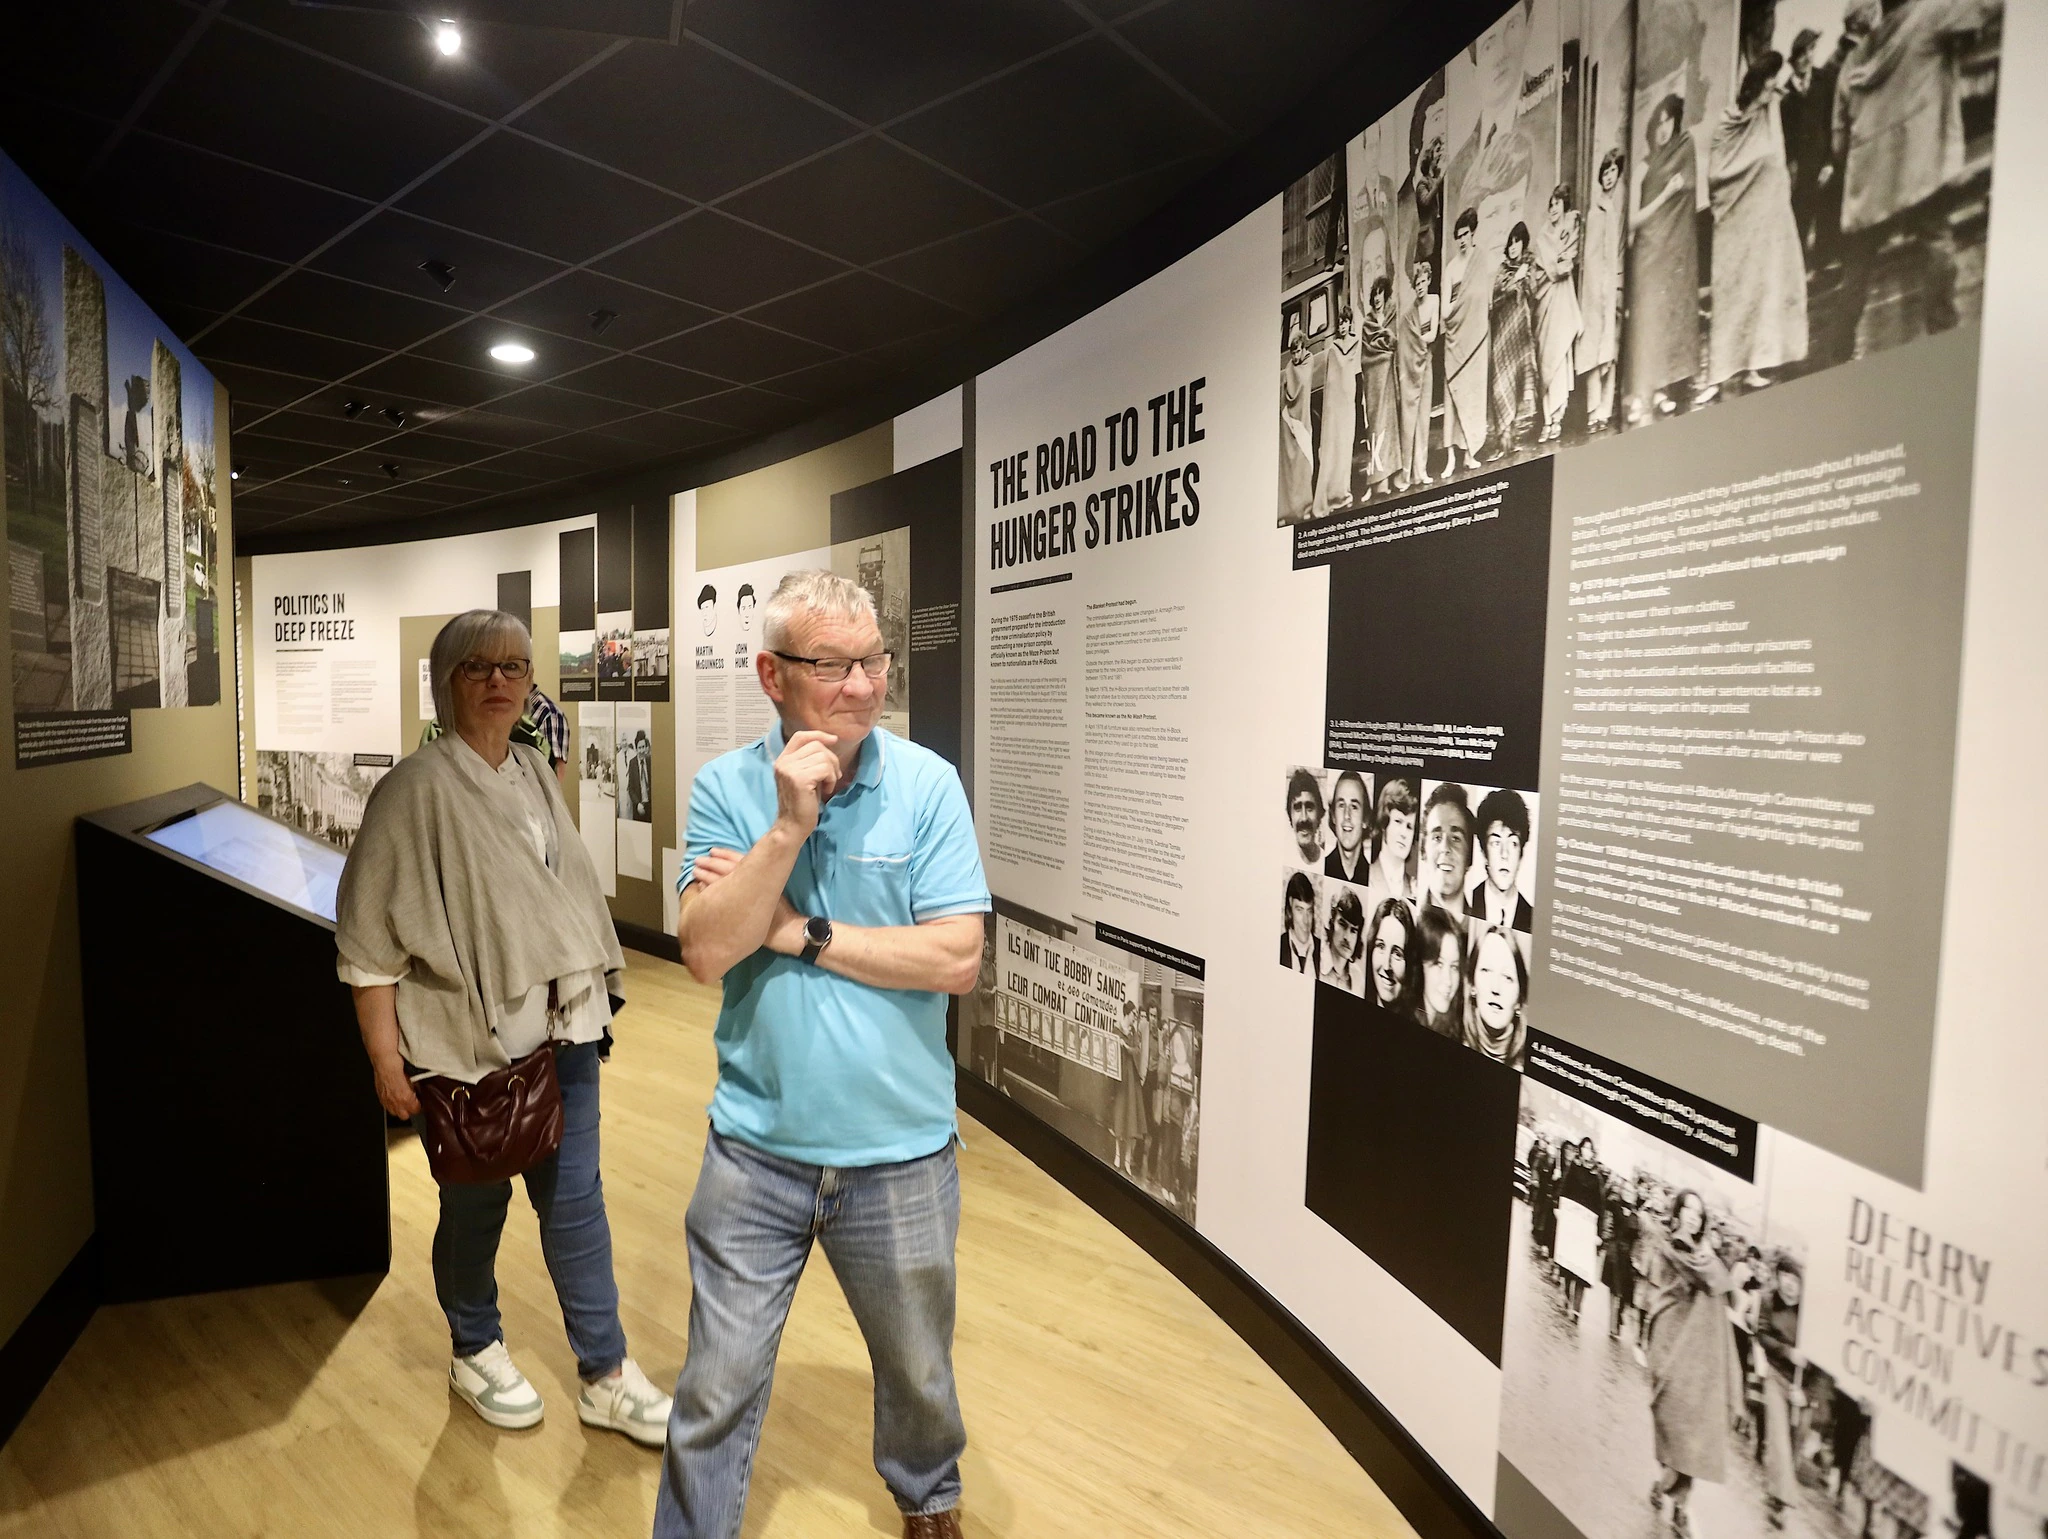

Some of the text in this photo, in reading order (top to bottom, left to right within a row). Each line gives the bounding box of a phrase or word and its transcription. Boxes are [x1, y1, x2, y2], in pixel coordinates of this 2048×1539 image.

[990, 376, 1206, 509] THE ROAD TO THE
[991, 462, 1200, 570] HUNGER STRIKES
[274, 593, 345, 616] POLITICS IN
[275, 619, 355, 642] DEEP FREEZE
[695, 645, 713, 656] MARTIN
[735, 643, 748, 655] JOHN
[735, 656, 748, 668] HUME
[1008, 932, 1021, 955] ILS
[1024, 940, 1040, 964] ONT
[1044, 948, 1061, 973] TUE
[1064, 957, 1092, 987] BOBBY
[1097, 971, 1126, 1002] SANDS
[1058, 980, 1065, 991] et
[1007, 970, 1029, 997] LEUR
[1032, 982, 1068, 1015] COMBAT
[1848, 1195, 1991, 1305] DERRY
[1844, 1246, 2048, 1387] RELATIVES
[1843, 1297, 1953, 1384] ACTION
